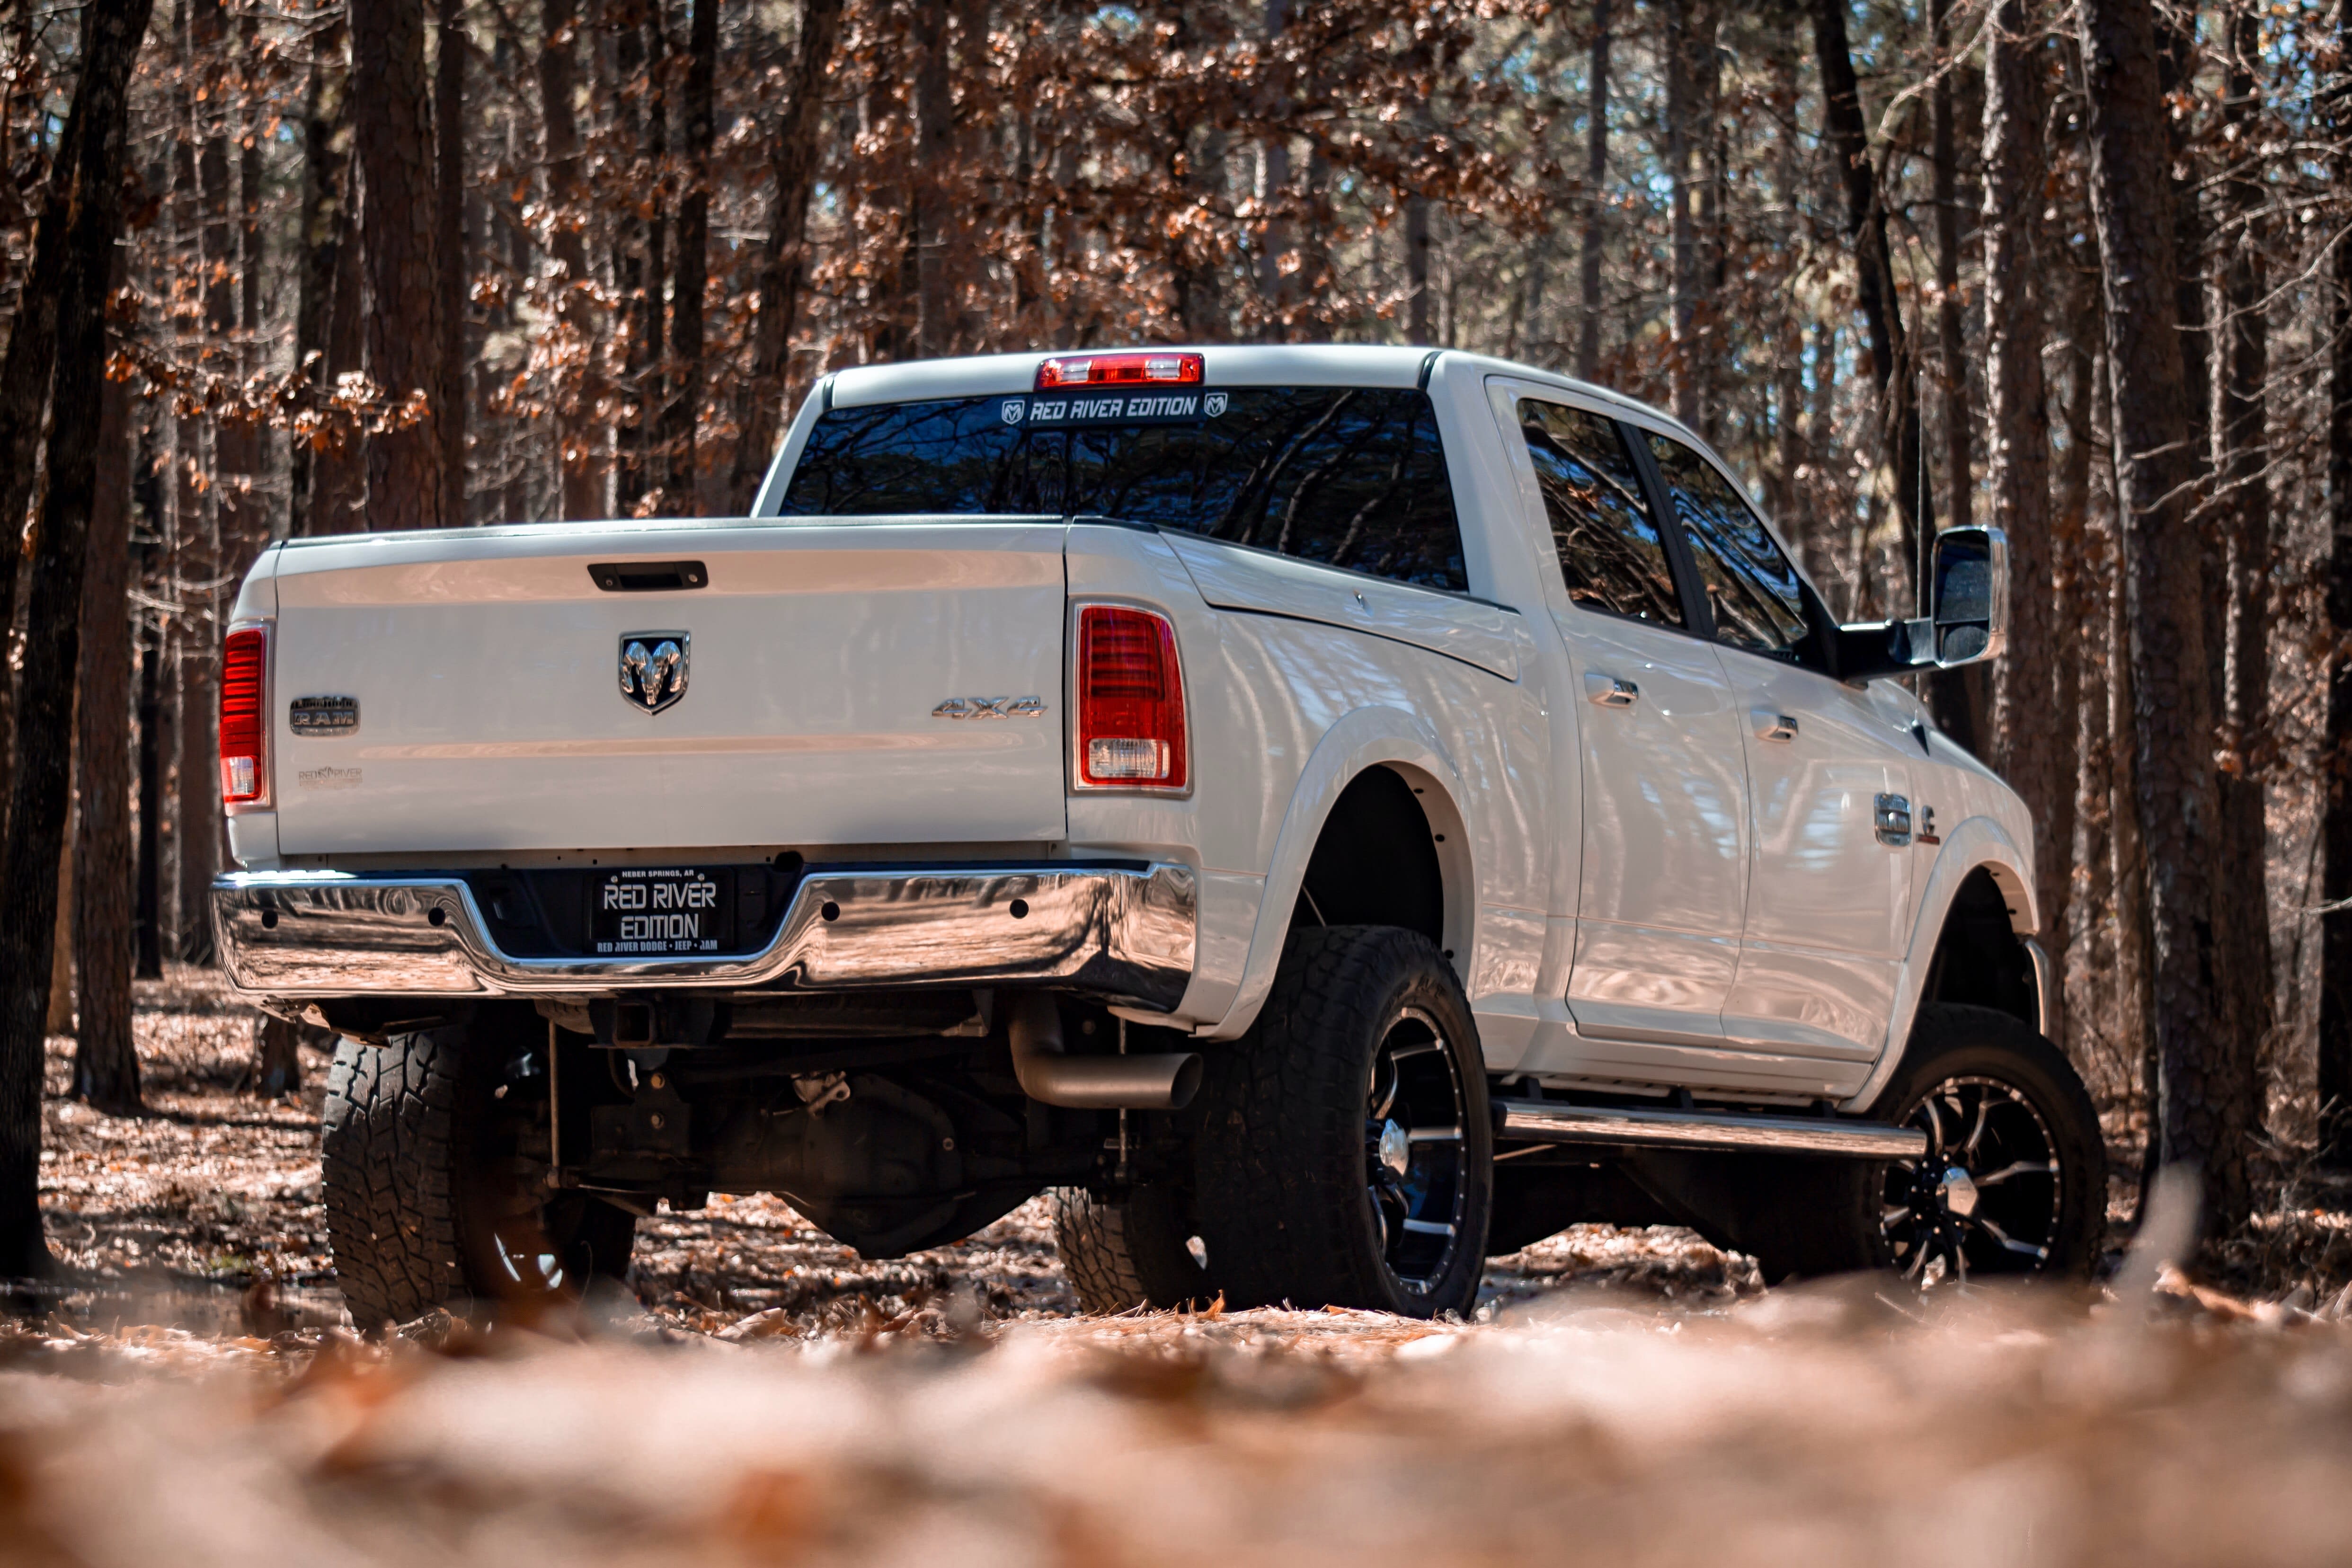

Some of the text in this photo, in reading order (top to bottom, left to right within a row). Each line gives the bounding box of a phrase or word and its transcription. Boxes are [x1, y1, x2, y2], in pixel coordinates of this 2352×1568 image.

[1030, 397, 1198, 421] RED RIVER EDITION
[294, 711, 354, 725] RAM
[604, 882, 717, 910] RED RIVER
[621, 913, 698, 939] EDITION
[597, 942, 612, 953] RED
[640, 941, 667, 951] DODGE
[675, 941, 692, 951] JEEP
